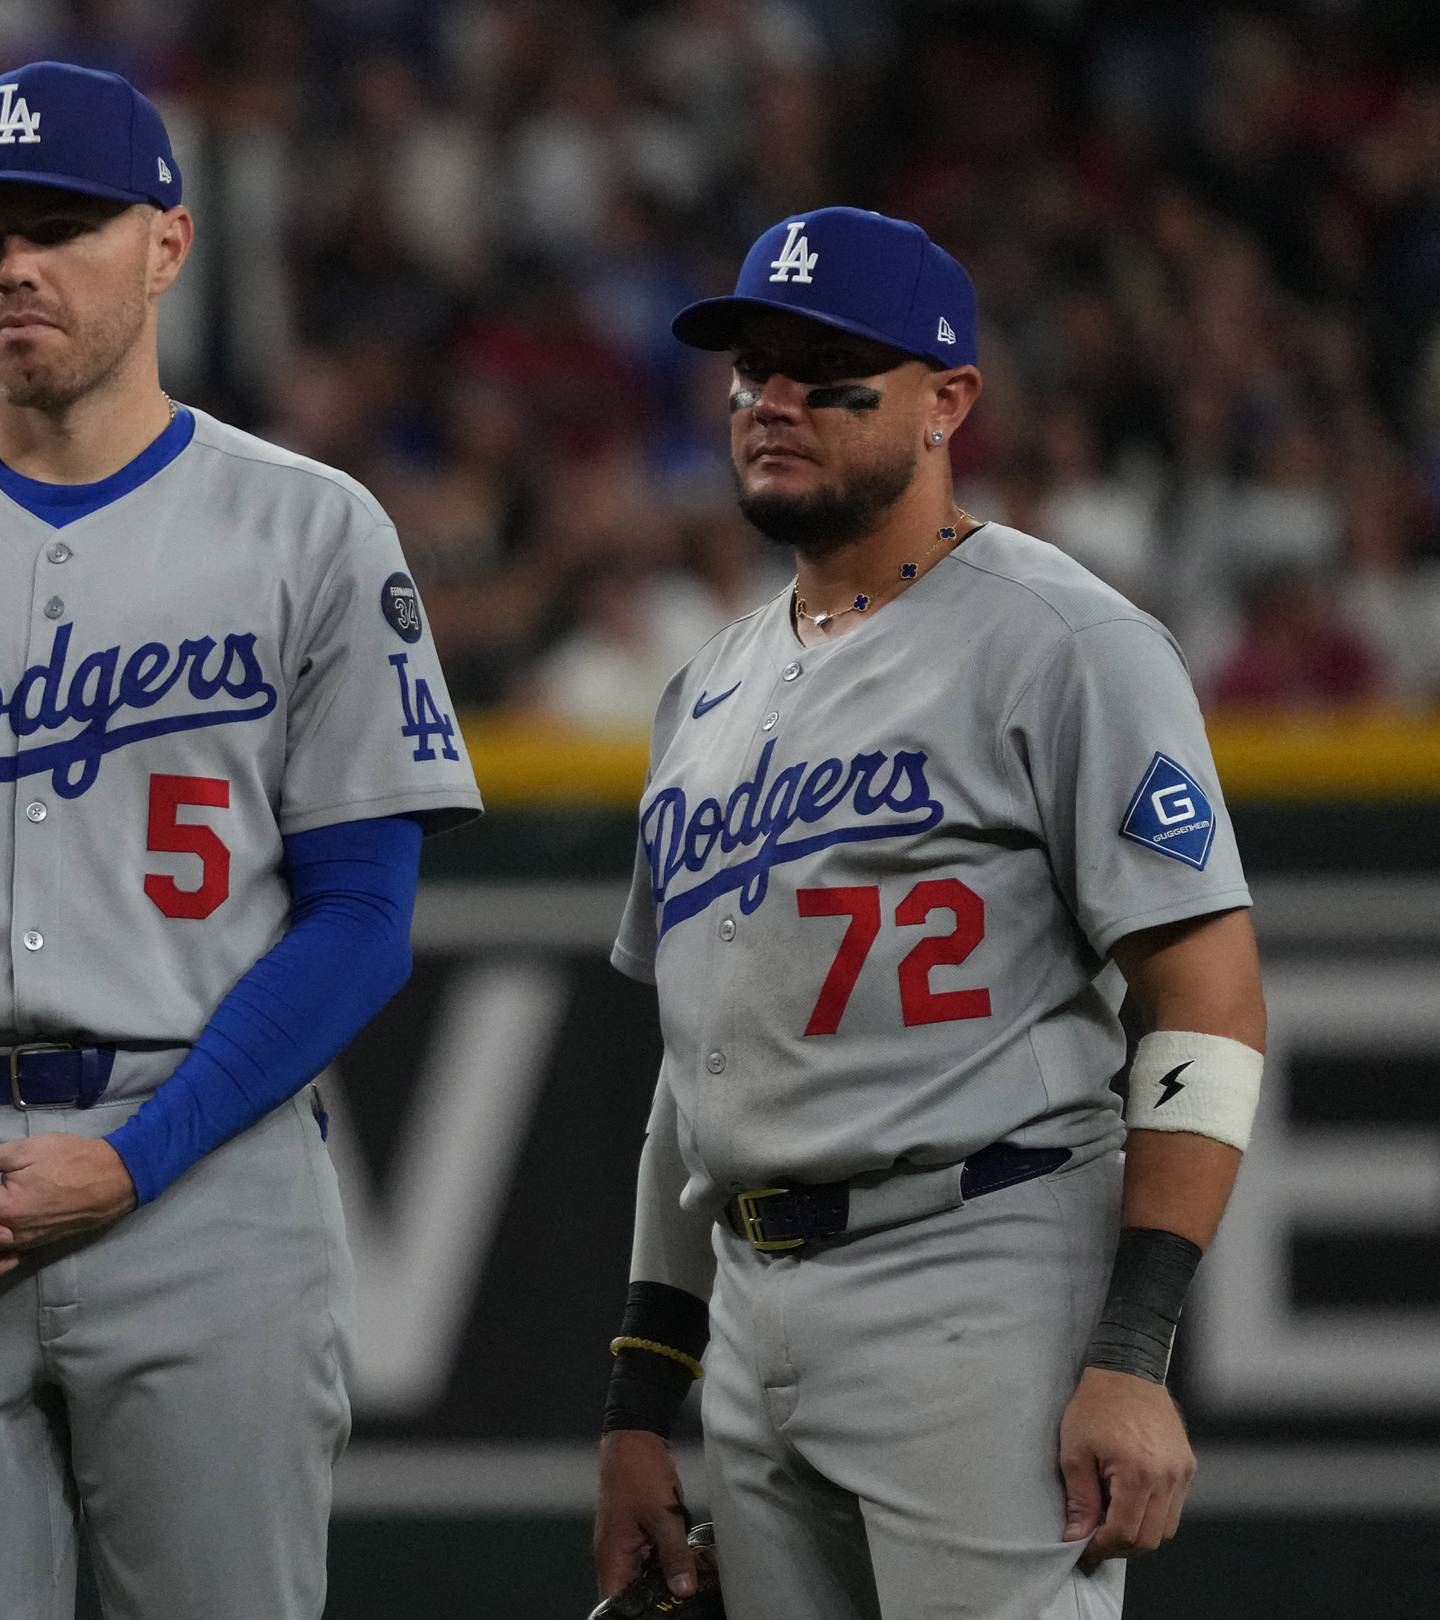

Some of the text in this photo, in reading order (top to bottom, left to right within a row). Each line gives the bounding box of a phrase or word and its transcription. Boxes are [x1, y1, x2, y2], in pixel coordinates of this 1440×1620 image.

[769, 221, 819, 284] LA
[395, 598, 419, 630] 34
[388, 652, 460, 762] LA
[144, 773, 231, 920] 5
[640, 737, 944, 915] Dodgers
[1151, 783, 1195, 825] G
[1154, 820, 1209, 842] GUGGENHEIM
[796, 877, 992, 1037] 72
